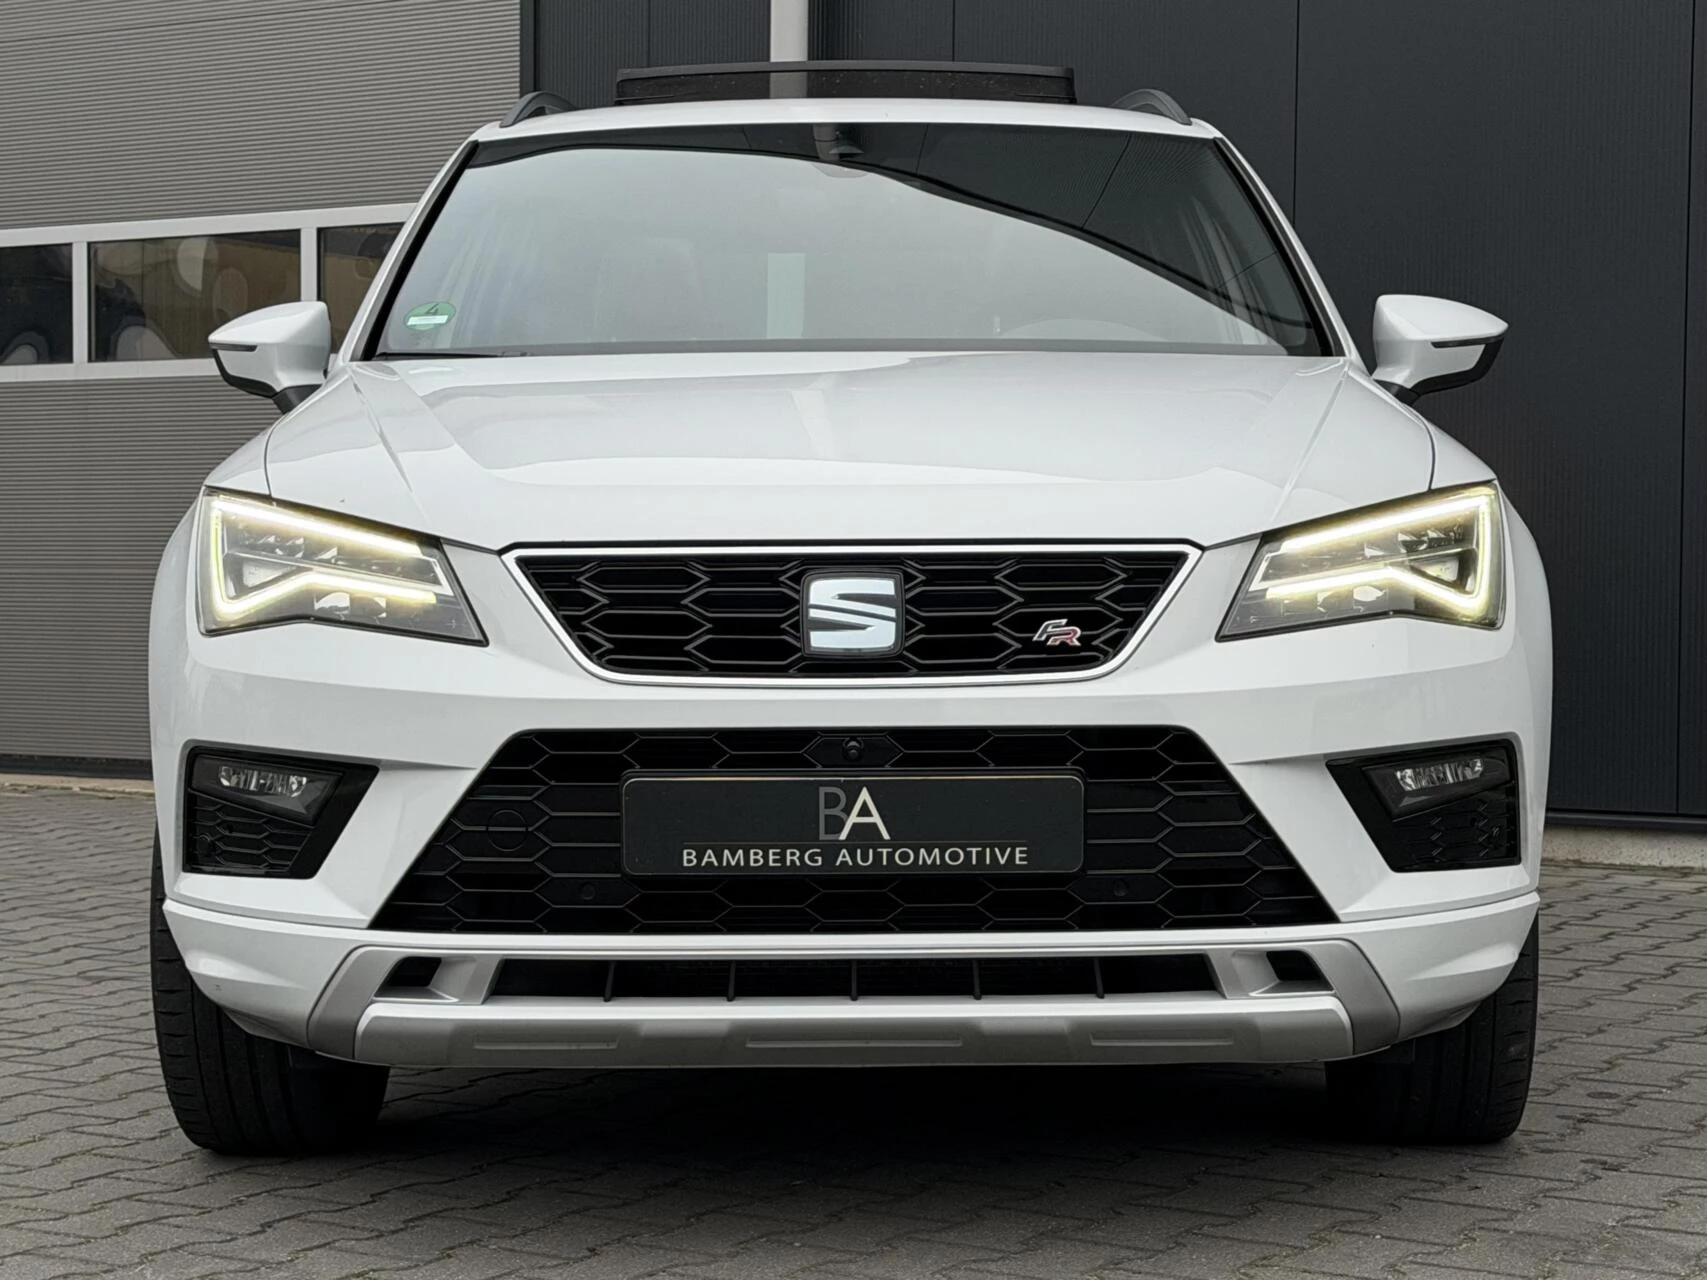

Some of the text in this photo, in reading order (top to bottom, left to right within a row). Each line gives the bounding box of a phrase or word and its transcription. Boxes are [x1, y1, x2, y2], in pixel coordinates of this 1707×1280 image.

[424, 303, 439, 315] 4
[1032, 618, 1082, 646] FR
[818, 786, 891, 841] BA
[682, 847, 1028, 867] BAMBERG AUTOMOTIVE
